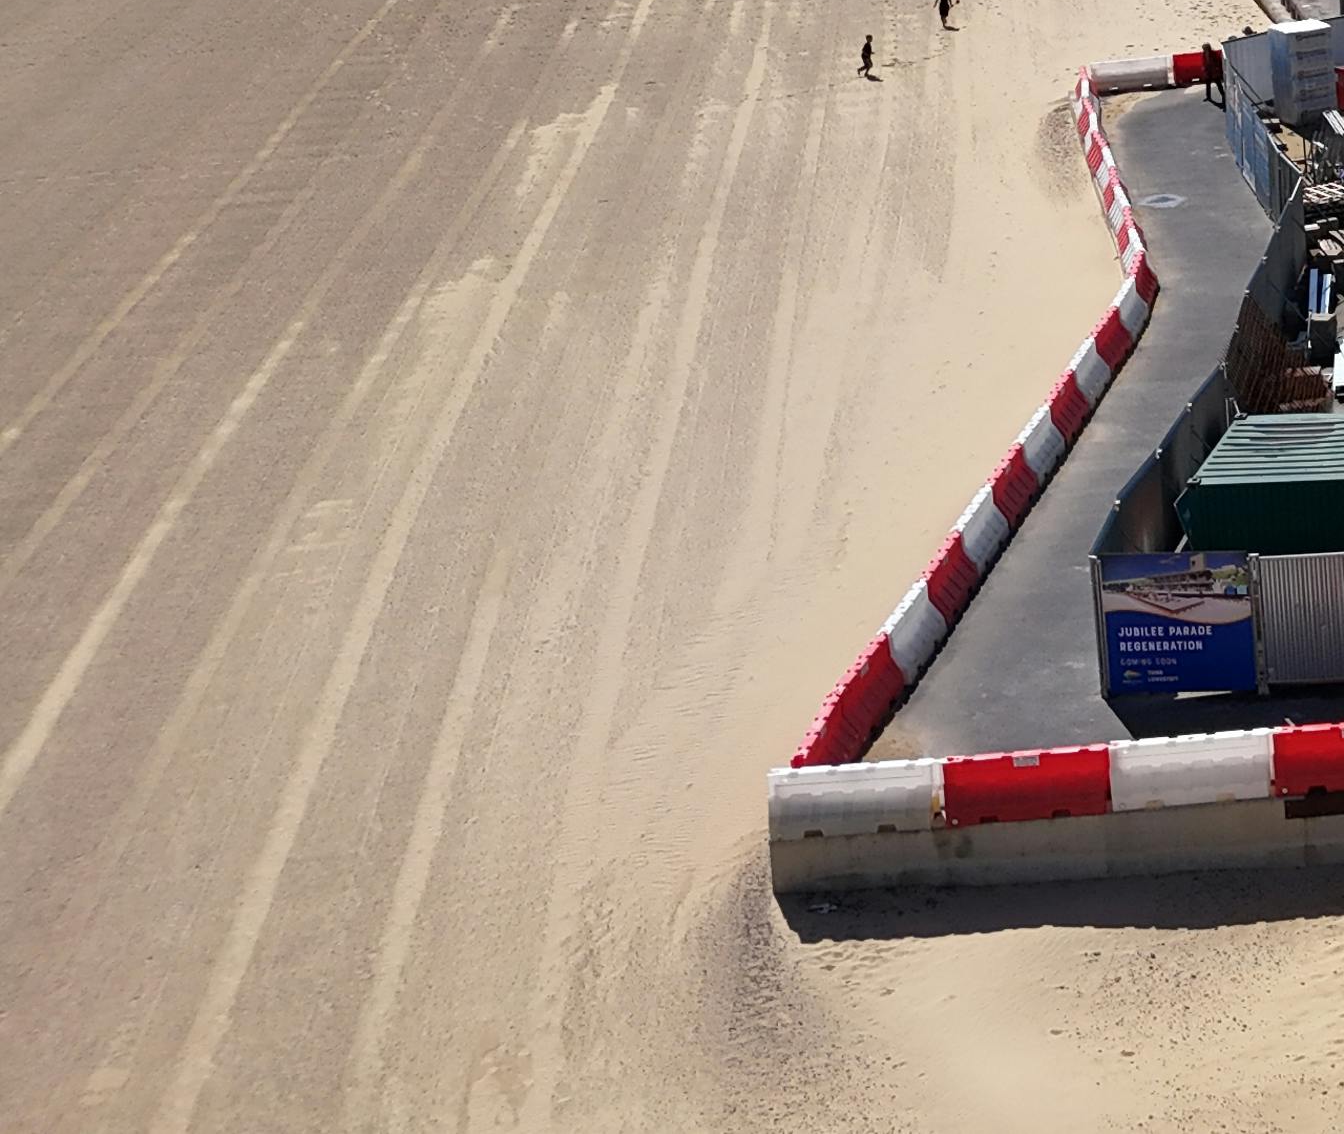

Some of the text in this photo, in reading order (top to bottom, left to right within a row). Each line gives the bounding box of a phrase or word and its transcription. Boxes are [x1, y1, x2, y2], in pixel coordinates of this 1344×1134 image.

[1118, 626, 1213, 637] JUBILEE PARADE
[1119, 640, 1203, 652] REGENERATION
